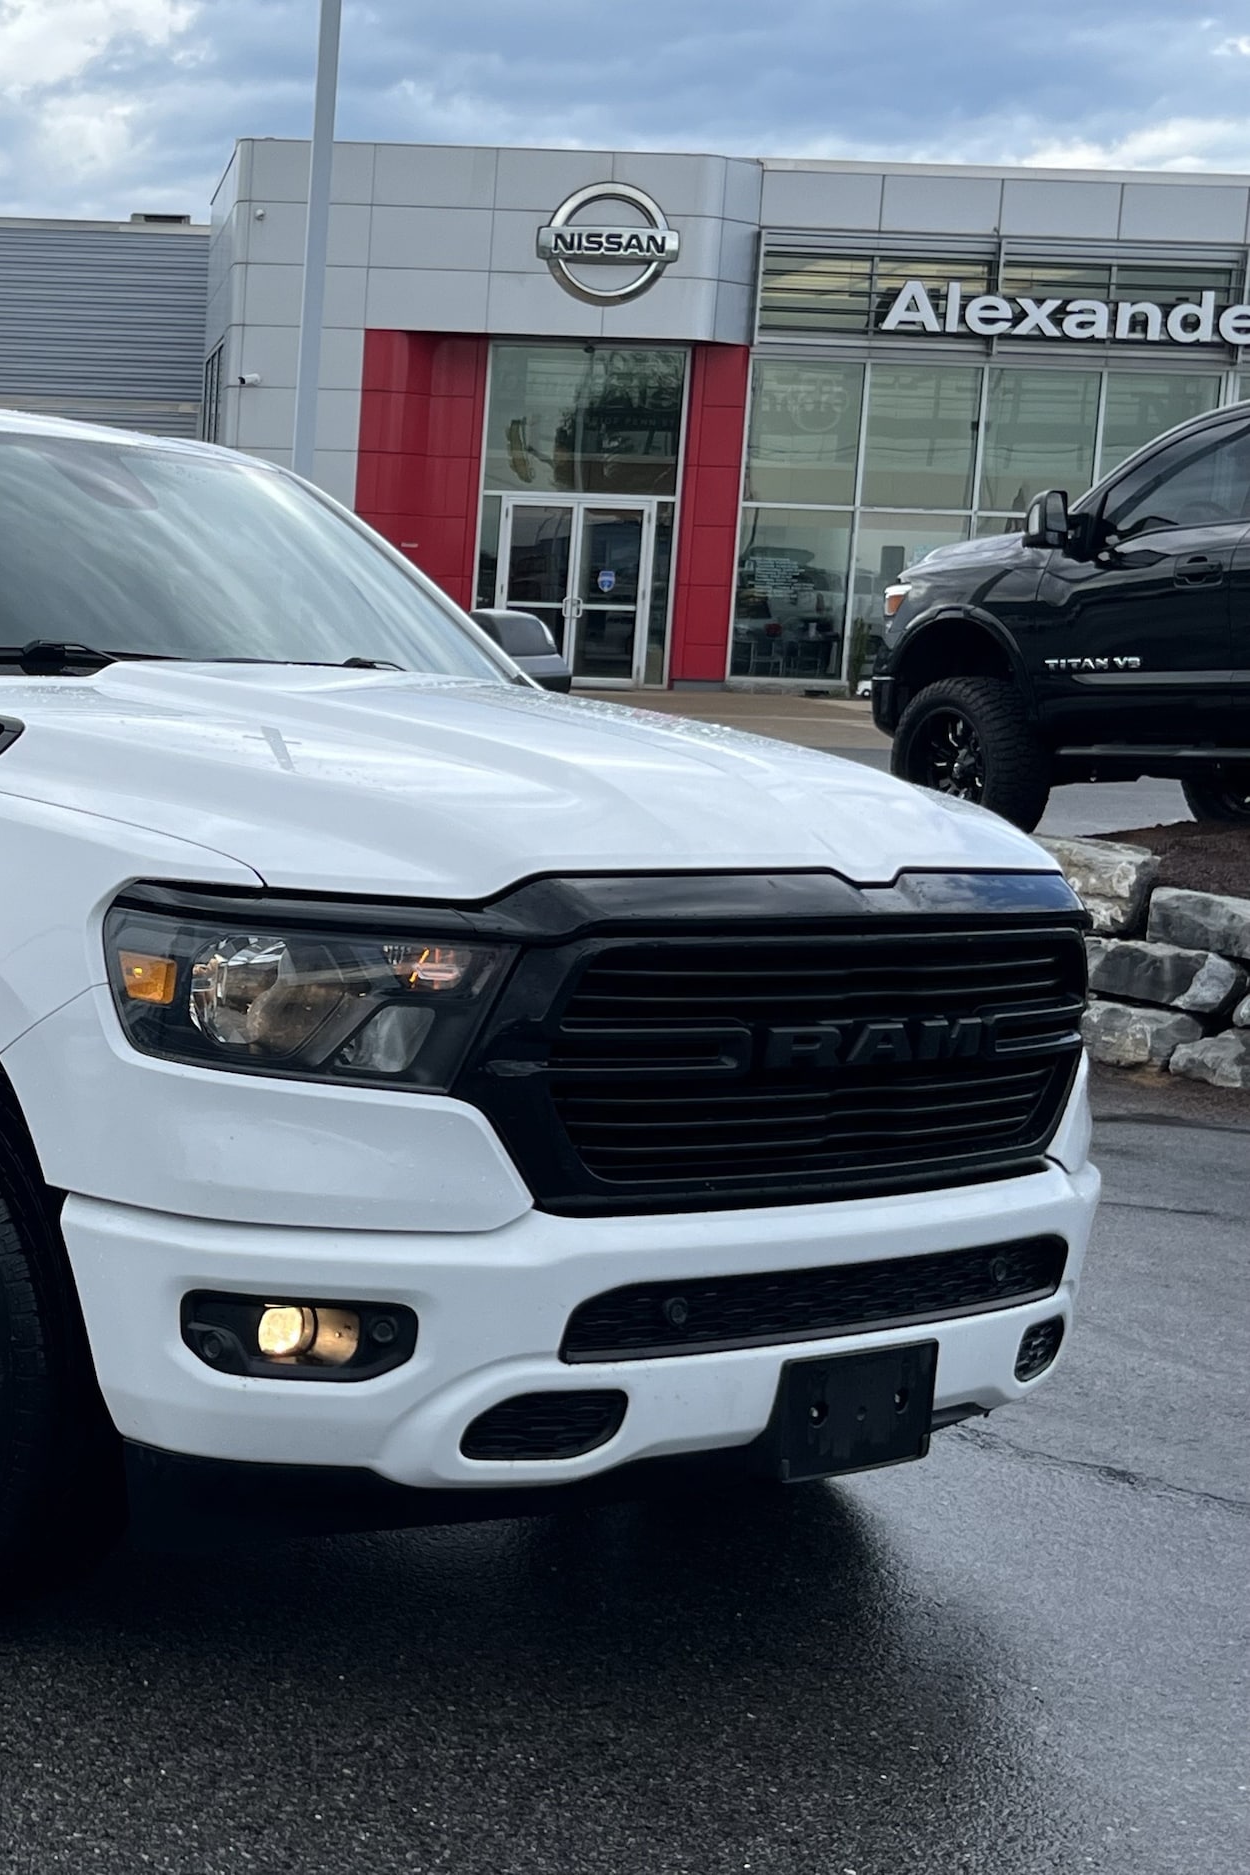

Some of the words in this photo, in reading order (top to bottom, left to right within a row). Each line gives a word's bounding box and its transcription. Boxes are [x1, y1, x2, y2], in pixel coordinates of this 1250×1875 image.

[552, 232, 667, 255] NISSAN
[881, 280, 1250, 345] Alexande
[1045, 658, 1109, 670] TITAN
[1113, 657, 1141, 669] V8
[763, 1016, 983, 1069] RAM
